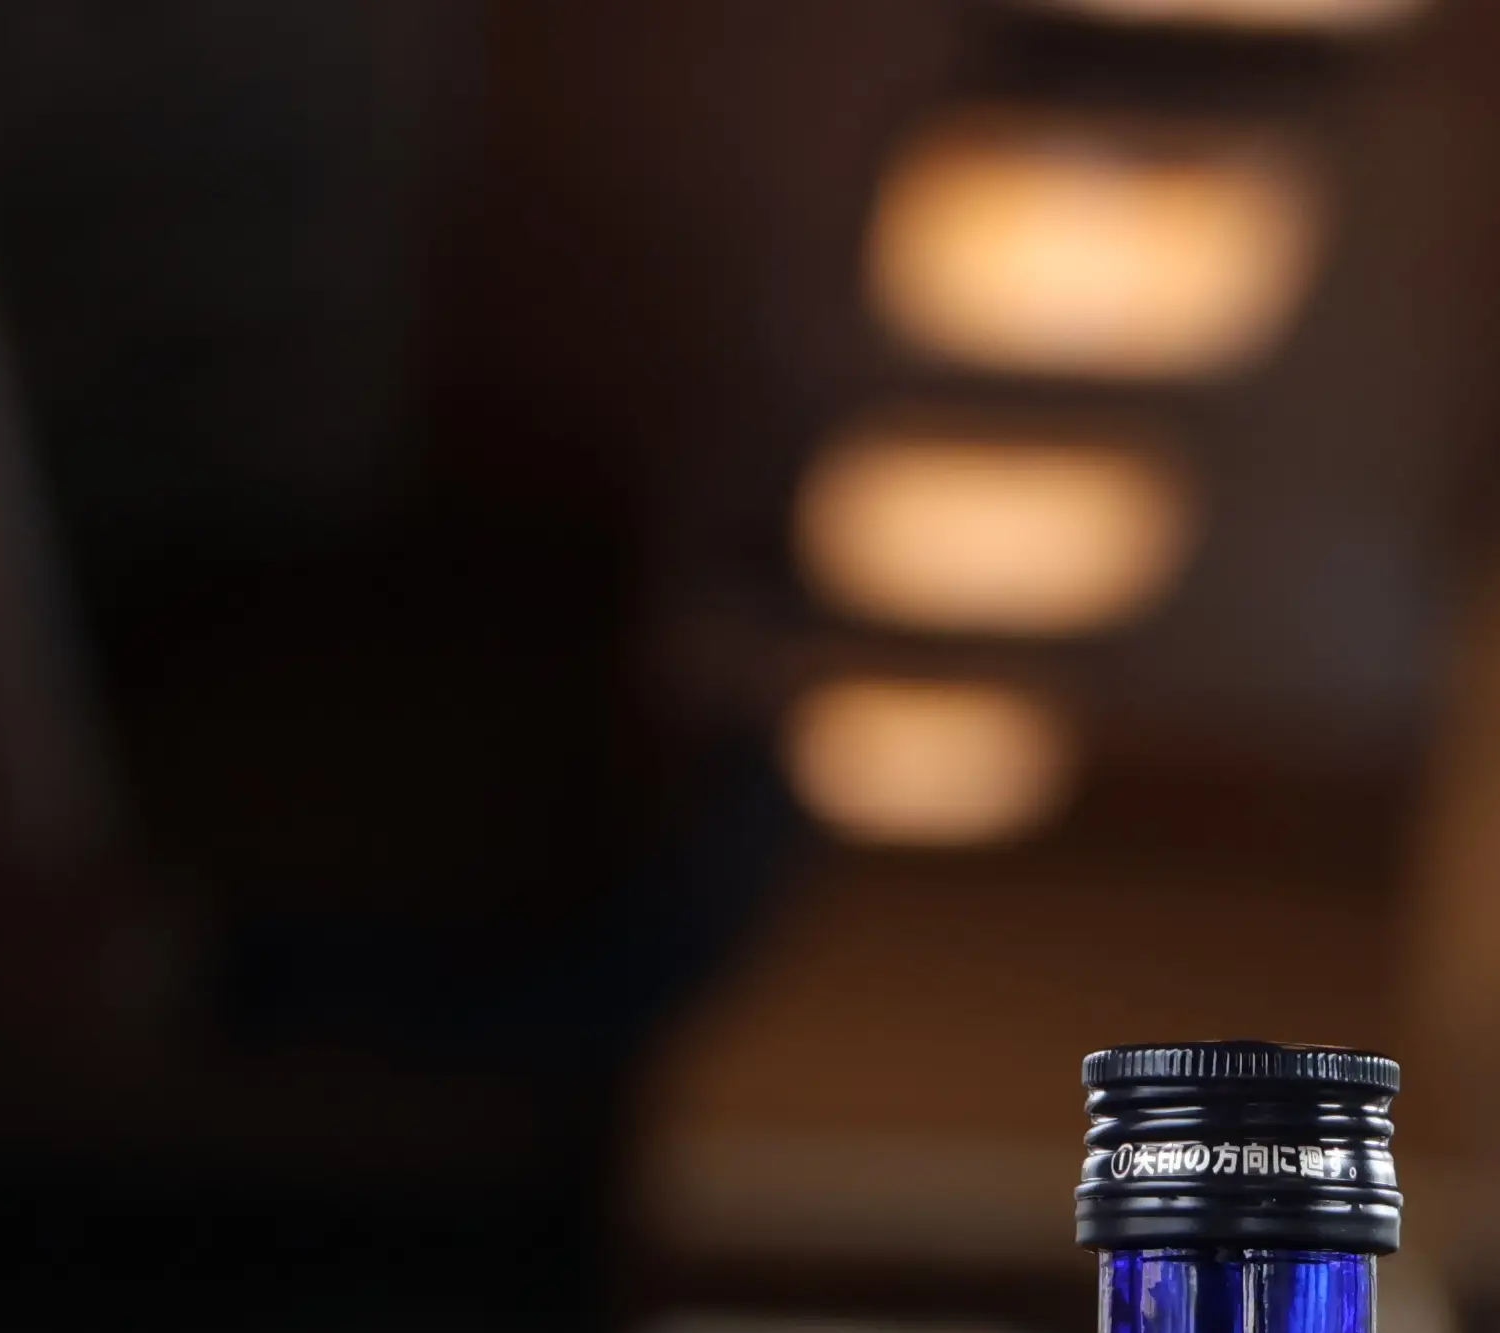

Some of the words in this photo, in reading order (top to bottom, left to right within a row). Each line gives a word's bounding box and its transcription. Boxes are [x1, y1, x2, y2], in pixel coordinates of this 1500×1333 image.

[1111, 1141, 1358, 1180] ①矢印の方向に廻す。
